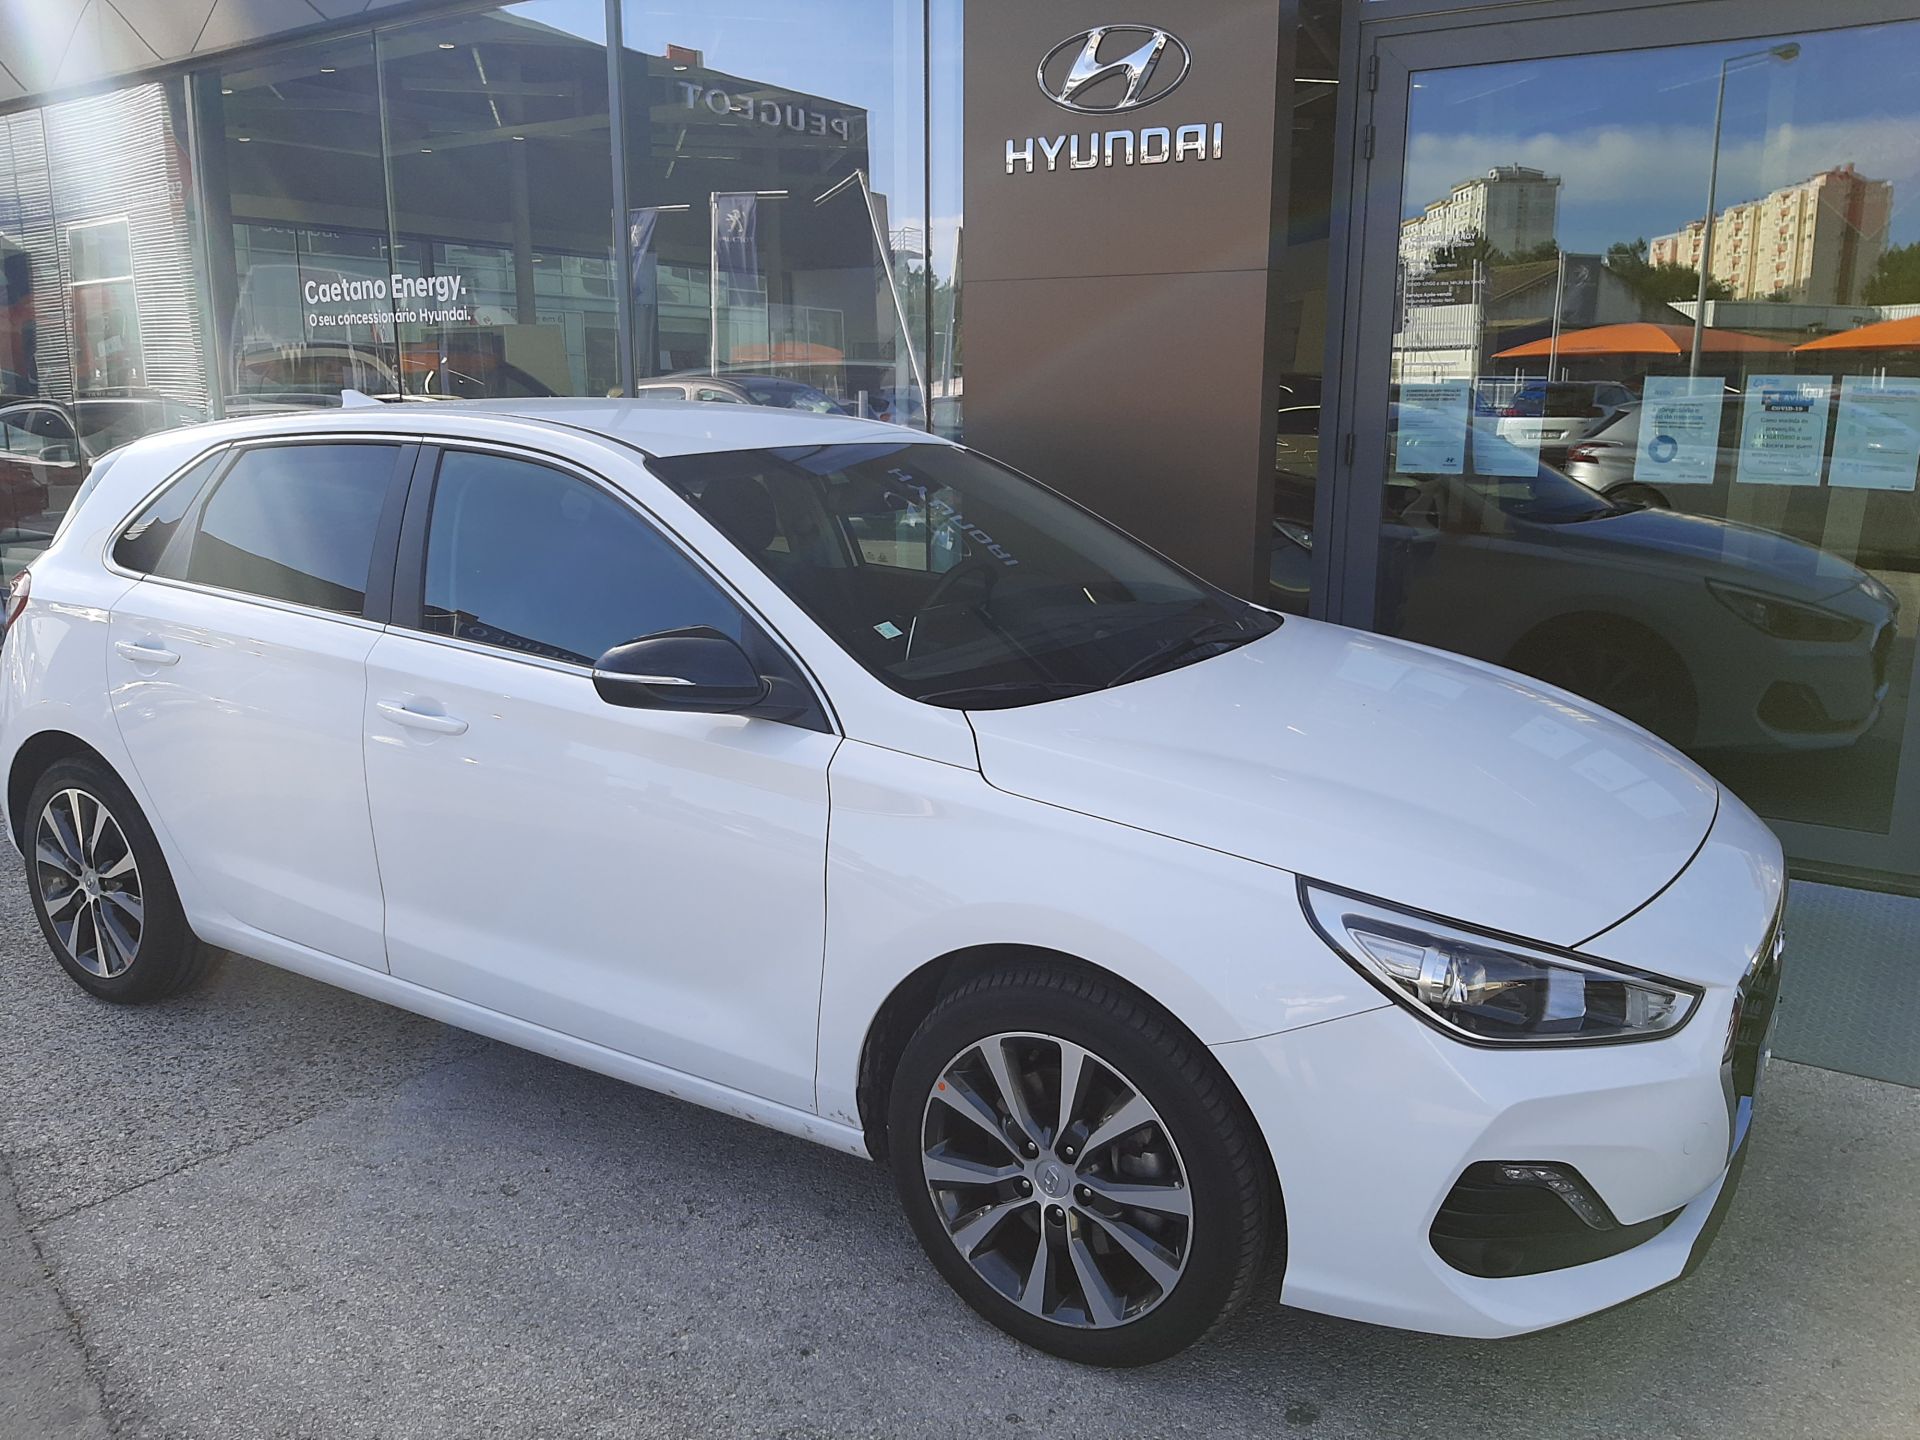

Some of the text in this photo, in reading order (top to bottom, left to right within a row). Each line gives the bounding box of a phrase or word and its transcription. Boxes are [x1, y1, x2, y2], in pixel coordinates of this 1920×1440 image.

[1005, 121, 1224, 175] HYUNDAI
[304, 274, 467, 304] Caetano Energy.
[309, 305, 472, 327] O seu concessionário Hyundai.
